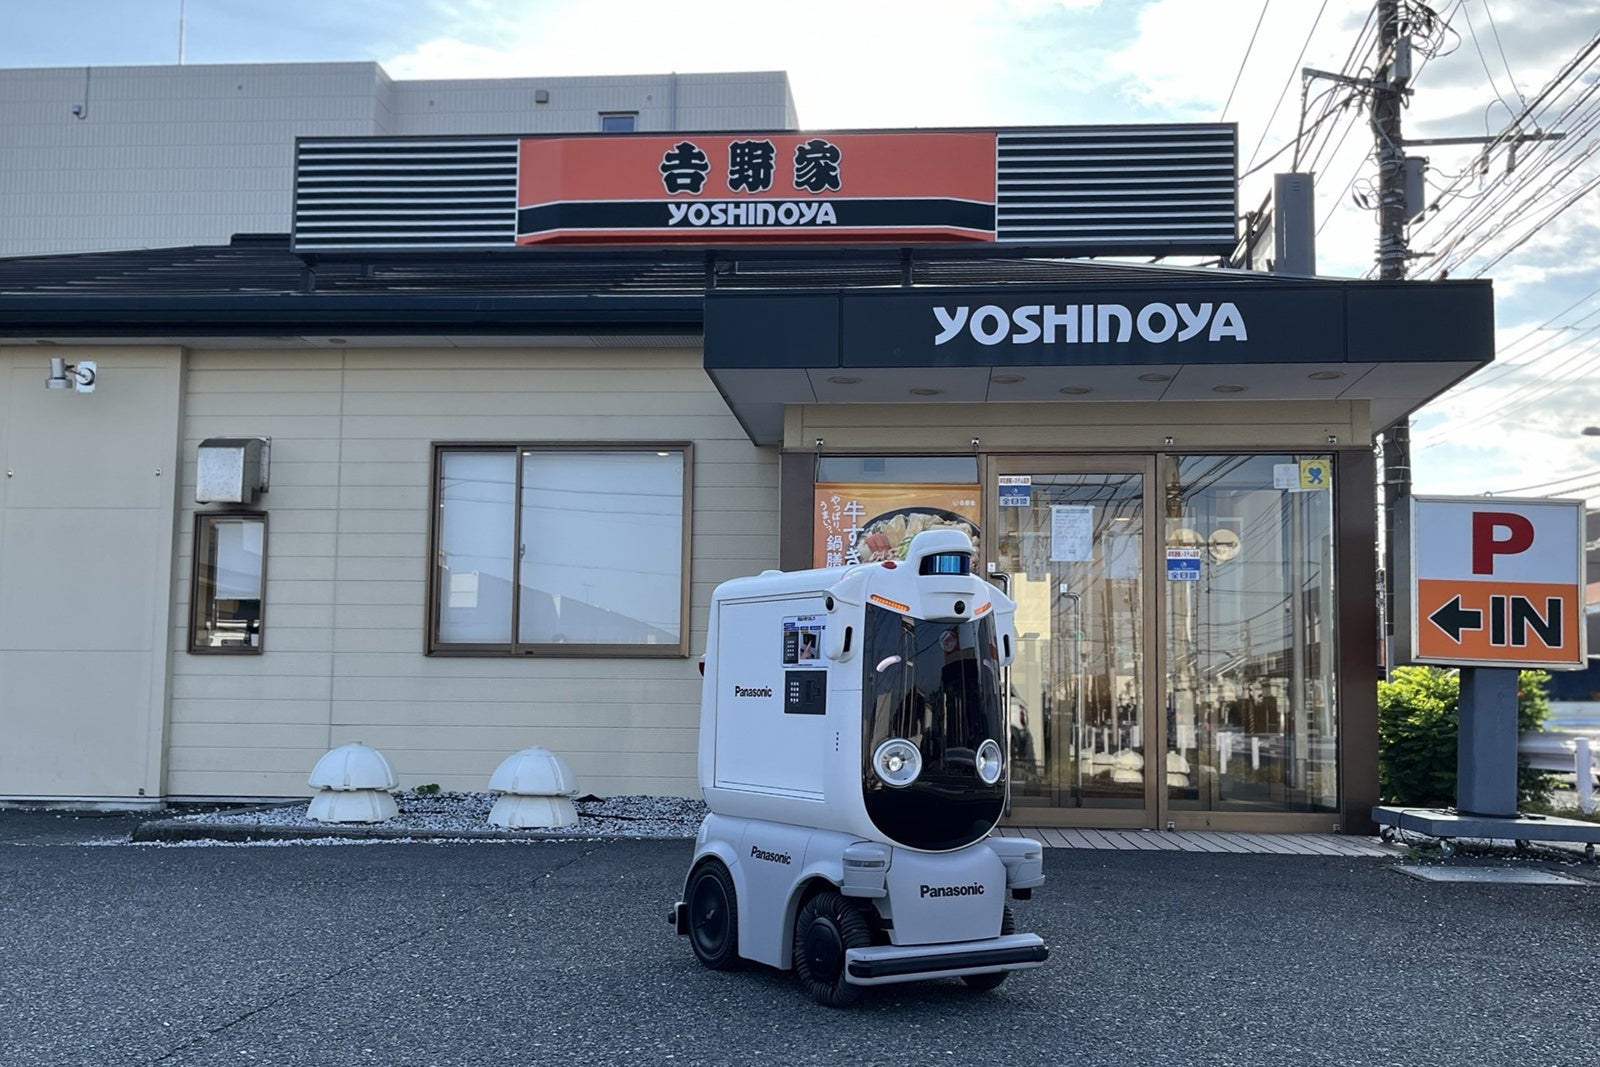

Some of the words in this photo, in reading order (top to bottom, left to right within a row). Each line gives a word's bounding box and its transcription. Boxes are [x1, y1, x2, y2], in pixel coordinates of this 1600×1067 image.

[668, 203, 837, 226] YOSHINOYA
[932, 302, 1248, 345] YOSHINOYA
[1472, 512, 1534, 574] P
[1490, 595, 1563, 648] IN
[735, 685, 773, 698] Panasonic
[750, 846, 792, 865] Panasonic
[920, 882, 984, 898] Panasonic
